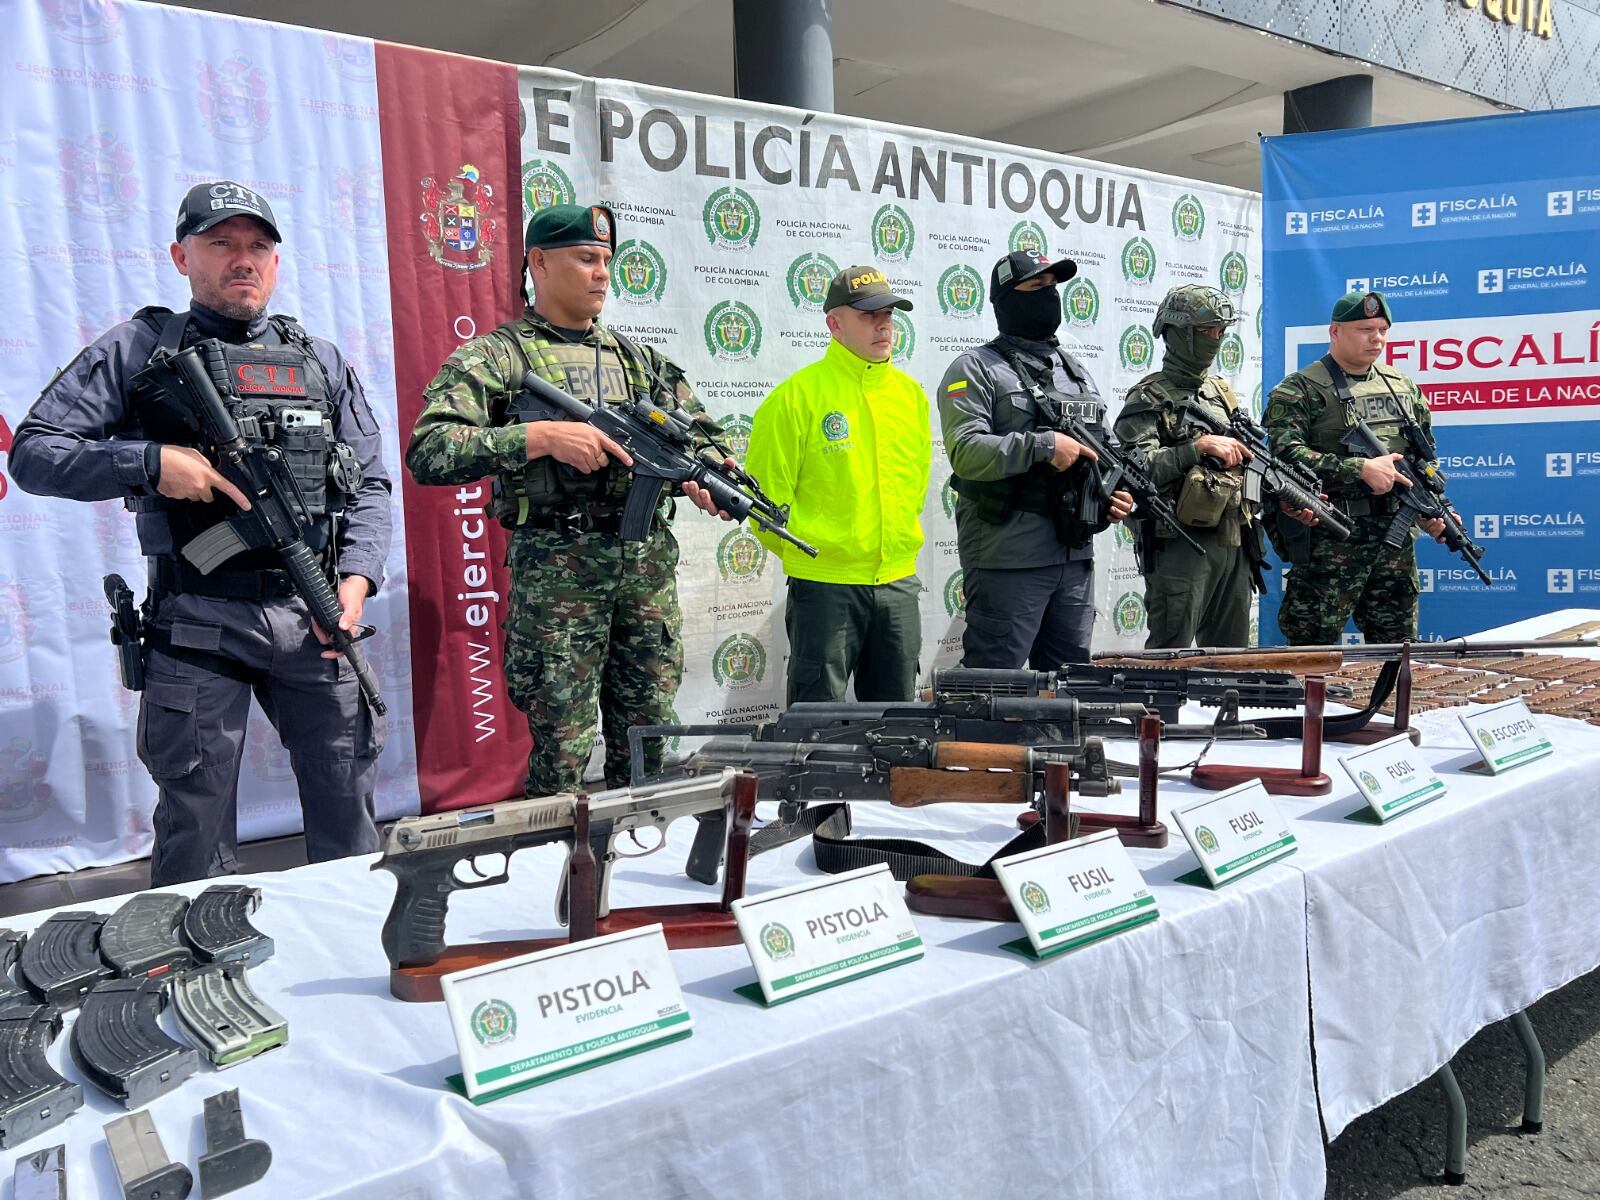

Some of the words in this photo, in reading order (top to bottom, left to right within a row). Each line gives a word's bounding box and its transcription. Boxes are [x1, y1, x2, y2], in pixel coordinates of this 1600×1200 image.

[519, 87, 571, 155] E
[600, 97, 861, 192] POLICÍA
[871, 140, 1147, 232] ANTIOQUIA
[209, 183, 261, 206] CTI
[1440, 193, 1518, 212] FISCALÍA
[635, 204, 677, 217] NACIONAL
[1310, 205, 1385, 222] FISCALÍA
[624, 214, 665, 226] COLOMBIA
[777, 219, 808, 229] POLICÍA
[810, 221, 852, 231] NACIONAL
[786, 230, 797, 238] DE
[799, 230, 842, 239] COLOMBIA
[958, 235, 992, 245] NACIONAL
[948, 244, 985, 252] COLOMBIA
[694, 265, 726, 274] POLICÍA
[728, 268, 770, 277] NACIONAL
[1507, 262, 1588, 279] FISCALÍA
[705, 276, 716, 284] DE
[718, 277, 760, 287] COLOMBIA
[1373, 271, 1449, 288] FISCALÍA
[1383, 291, 1404, 299] NERAL
[607, 324, 632, 333] OLICÍA
[635, 326, 679, 335] NACIONAL
[780, 331, 811, 339] POLICÍA
[791, 340, 802, 348] DE
[1386, 320, 1600, 371] FISCALÍ
[696, 380, 729, 389] POLICÍA
[731, 381, 775, 389] NACIONAL
[707, 390, 718, 398] DE
[720, 390, 765, 398] COLOMBIA
[1427, 390, 1486, 406] NERAL
[1491, 388, 1520, 403] DE
[1526, 387, 1552, 402] LA
[1557, 384, 1600, 401] NAC
[1065, 402, 1095, 417] CTI
[1437, 453, 1516, 467] FISCALÍA
[1503, 511, 1585, 526] FISCALÍA
[737, 600, 773, 610] NACIONAL
[716, 613, 727, 621] DE
[728, 609, 764, 619] COLOMBIA
[706, 707, 738, 718] POLICÍA
[739, 703, 780, 714] NACIONAL
[729, 713, 770, 724] COLOMBIA
[1491, 719, 1536, 741] ESCOPETA
[1386, 760, 1415, 779] FUSIL
[1229, 811, 1264, 834] FUSIL
[1068, 866, 1114, 893] FUSIL
[805, 902, 888, 940] PISTOLA
[836, 929, 872, 944] EVIDENCIA
[794, 963, 839, 983] DEPARTAMENTO
[840, 960, 848, 969] DE
[537, 969, 651, 1019] PISTOLA
[575, 1003, 624, 1025] EVIDENCIA
[510, 1049, 573, 1073] DEPARTAMENTO
[574, 1044, 585, 1054] DE
[586, 1034, 616, 1052] POLICÍA
[616, 1023, 659, 1044] ANTIOQUIA
